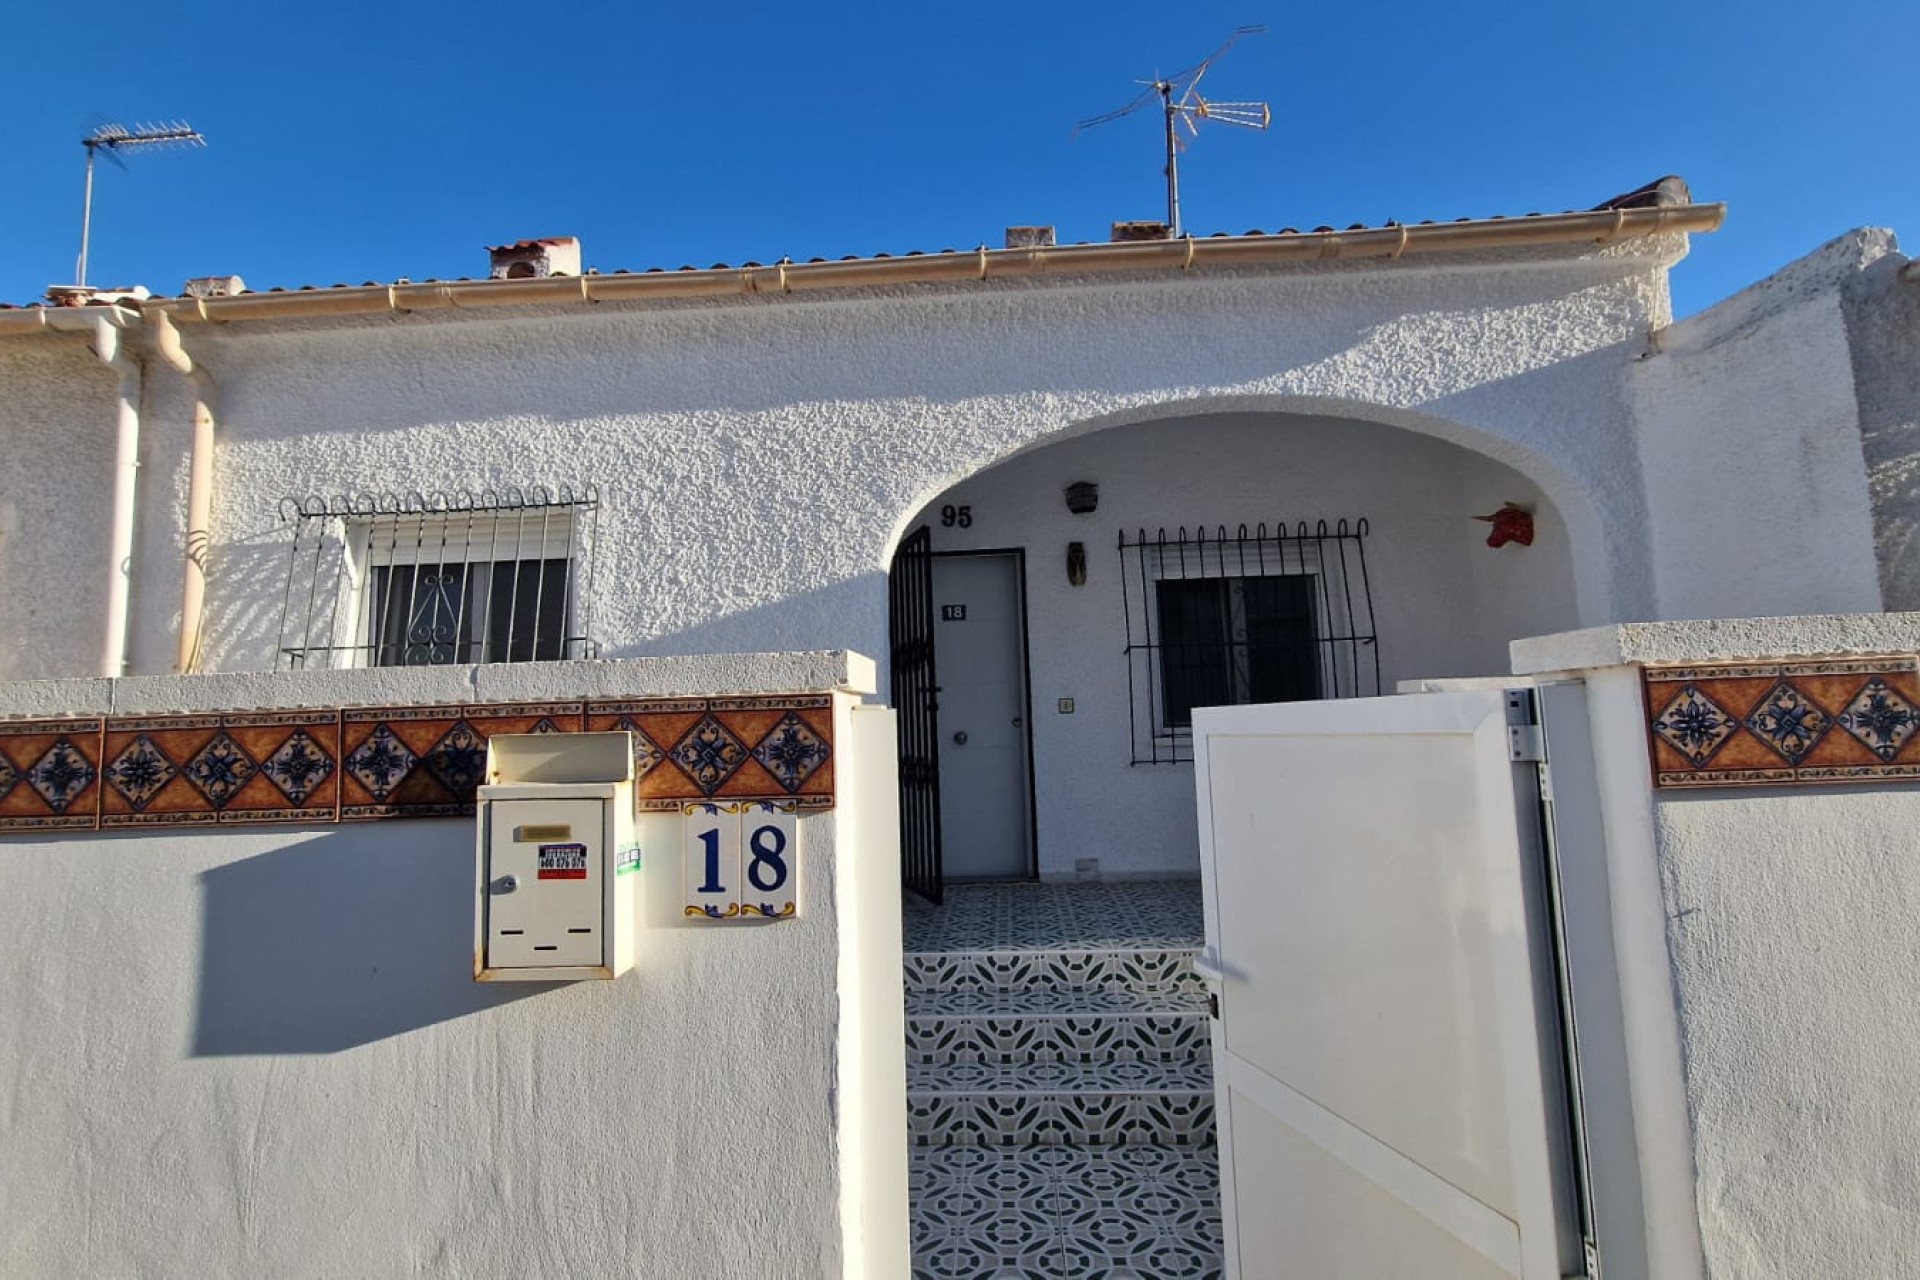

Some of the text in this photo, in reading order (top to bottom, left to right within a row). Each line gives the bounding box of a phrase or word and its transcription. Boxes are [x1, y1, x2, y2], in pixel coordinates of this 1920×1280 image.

[941, 504, 972, 529] 95
[947, 606, 962, 618] 18
[697, 825, 787, 893] 18
